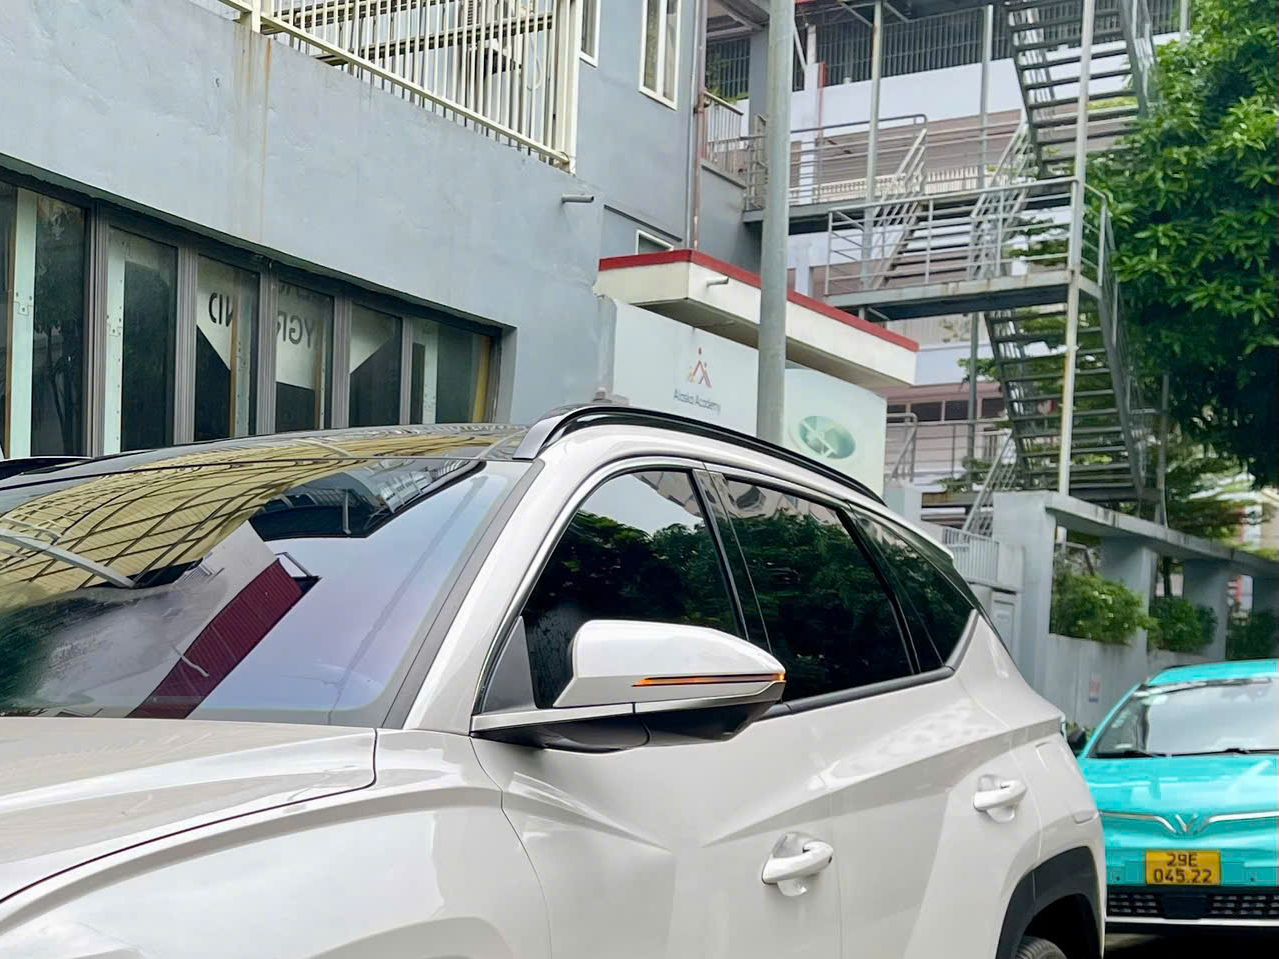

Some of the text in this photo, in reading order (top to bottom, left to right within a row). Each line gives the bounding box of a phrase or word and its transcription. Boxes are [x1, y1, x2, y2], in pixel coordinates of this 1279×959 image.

[673, 388, 694, 405] Alaska
[1167, 853, 1198, 868] 29E
[1153, 868, 1212, 883] 045.22
